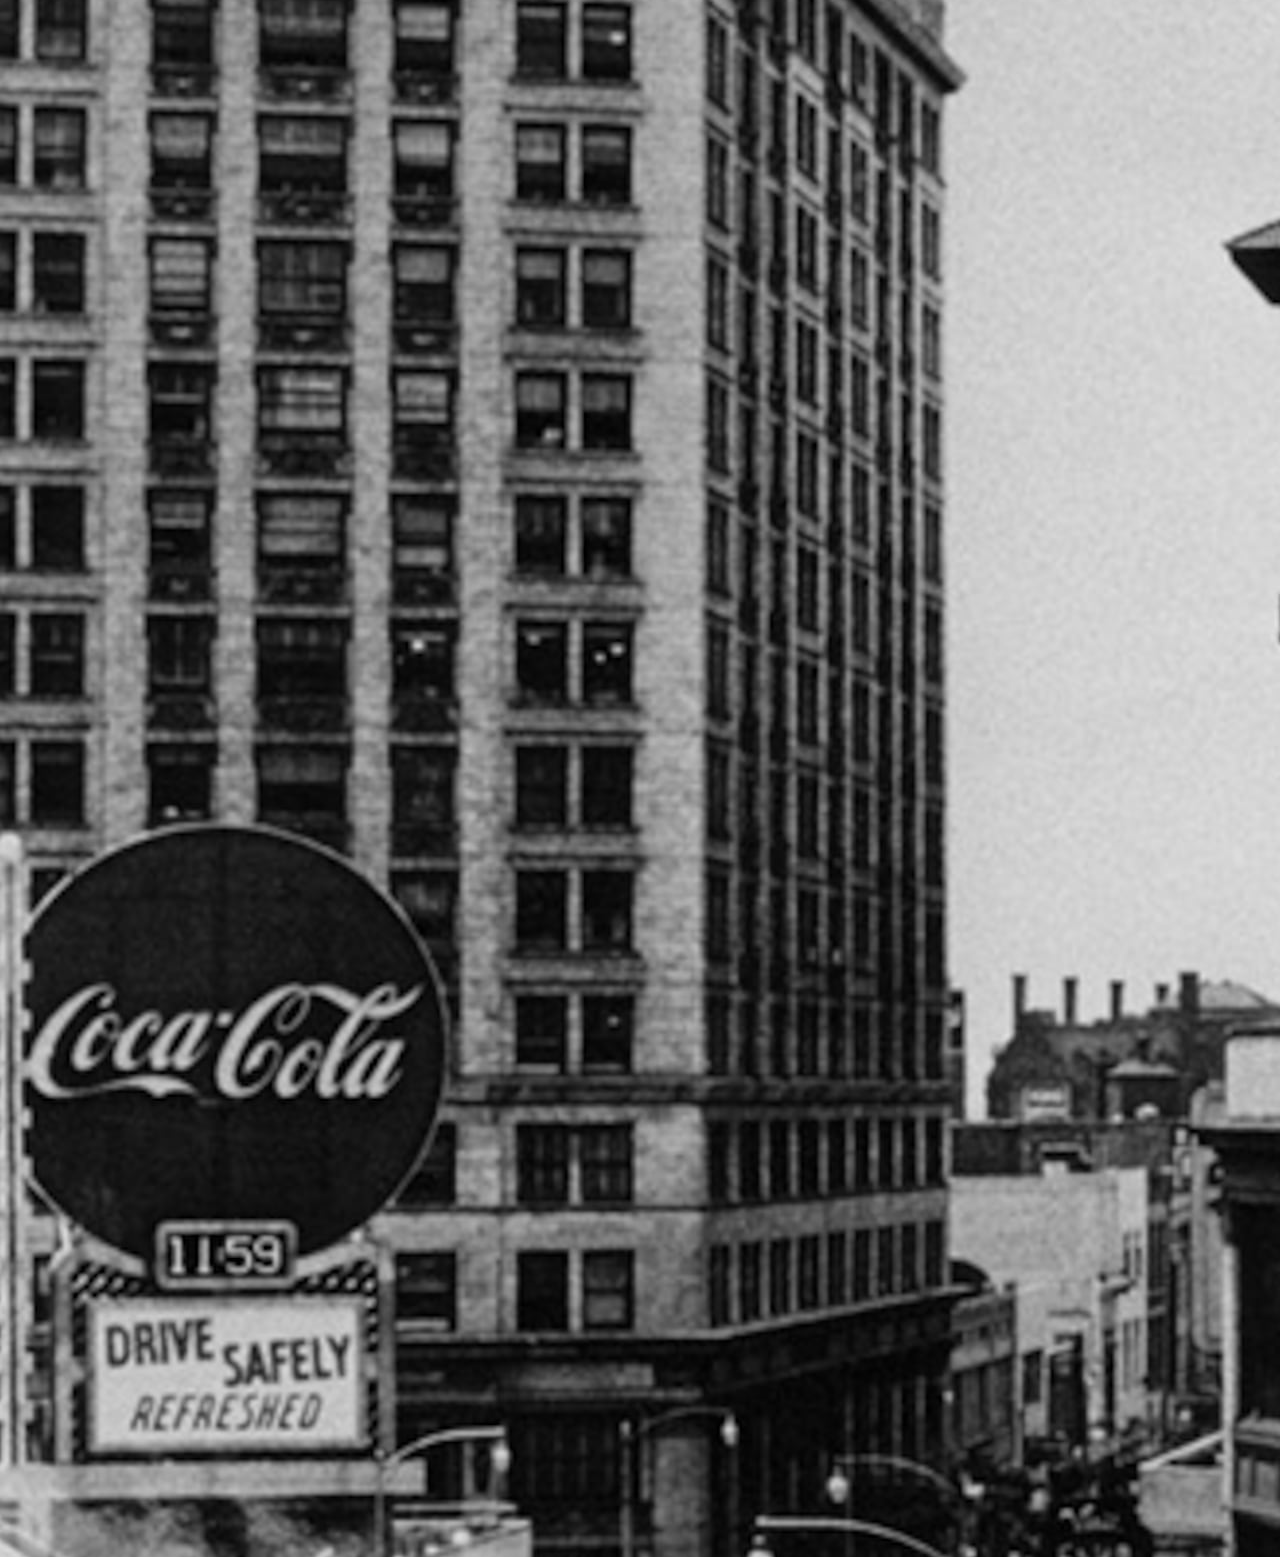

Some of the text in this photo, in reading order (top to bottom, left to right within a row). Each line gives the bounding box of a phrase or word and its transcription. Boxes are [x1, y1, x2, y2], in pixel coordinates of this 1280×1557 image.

[107, 1318, 214, 1368] DRIVE
[224, 1335, 350, 1387] SAFELY
[130, 1394, 322, 1432] REFRESHED
